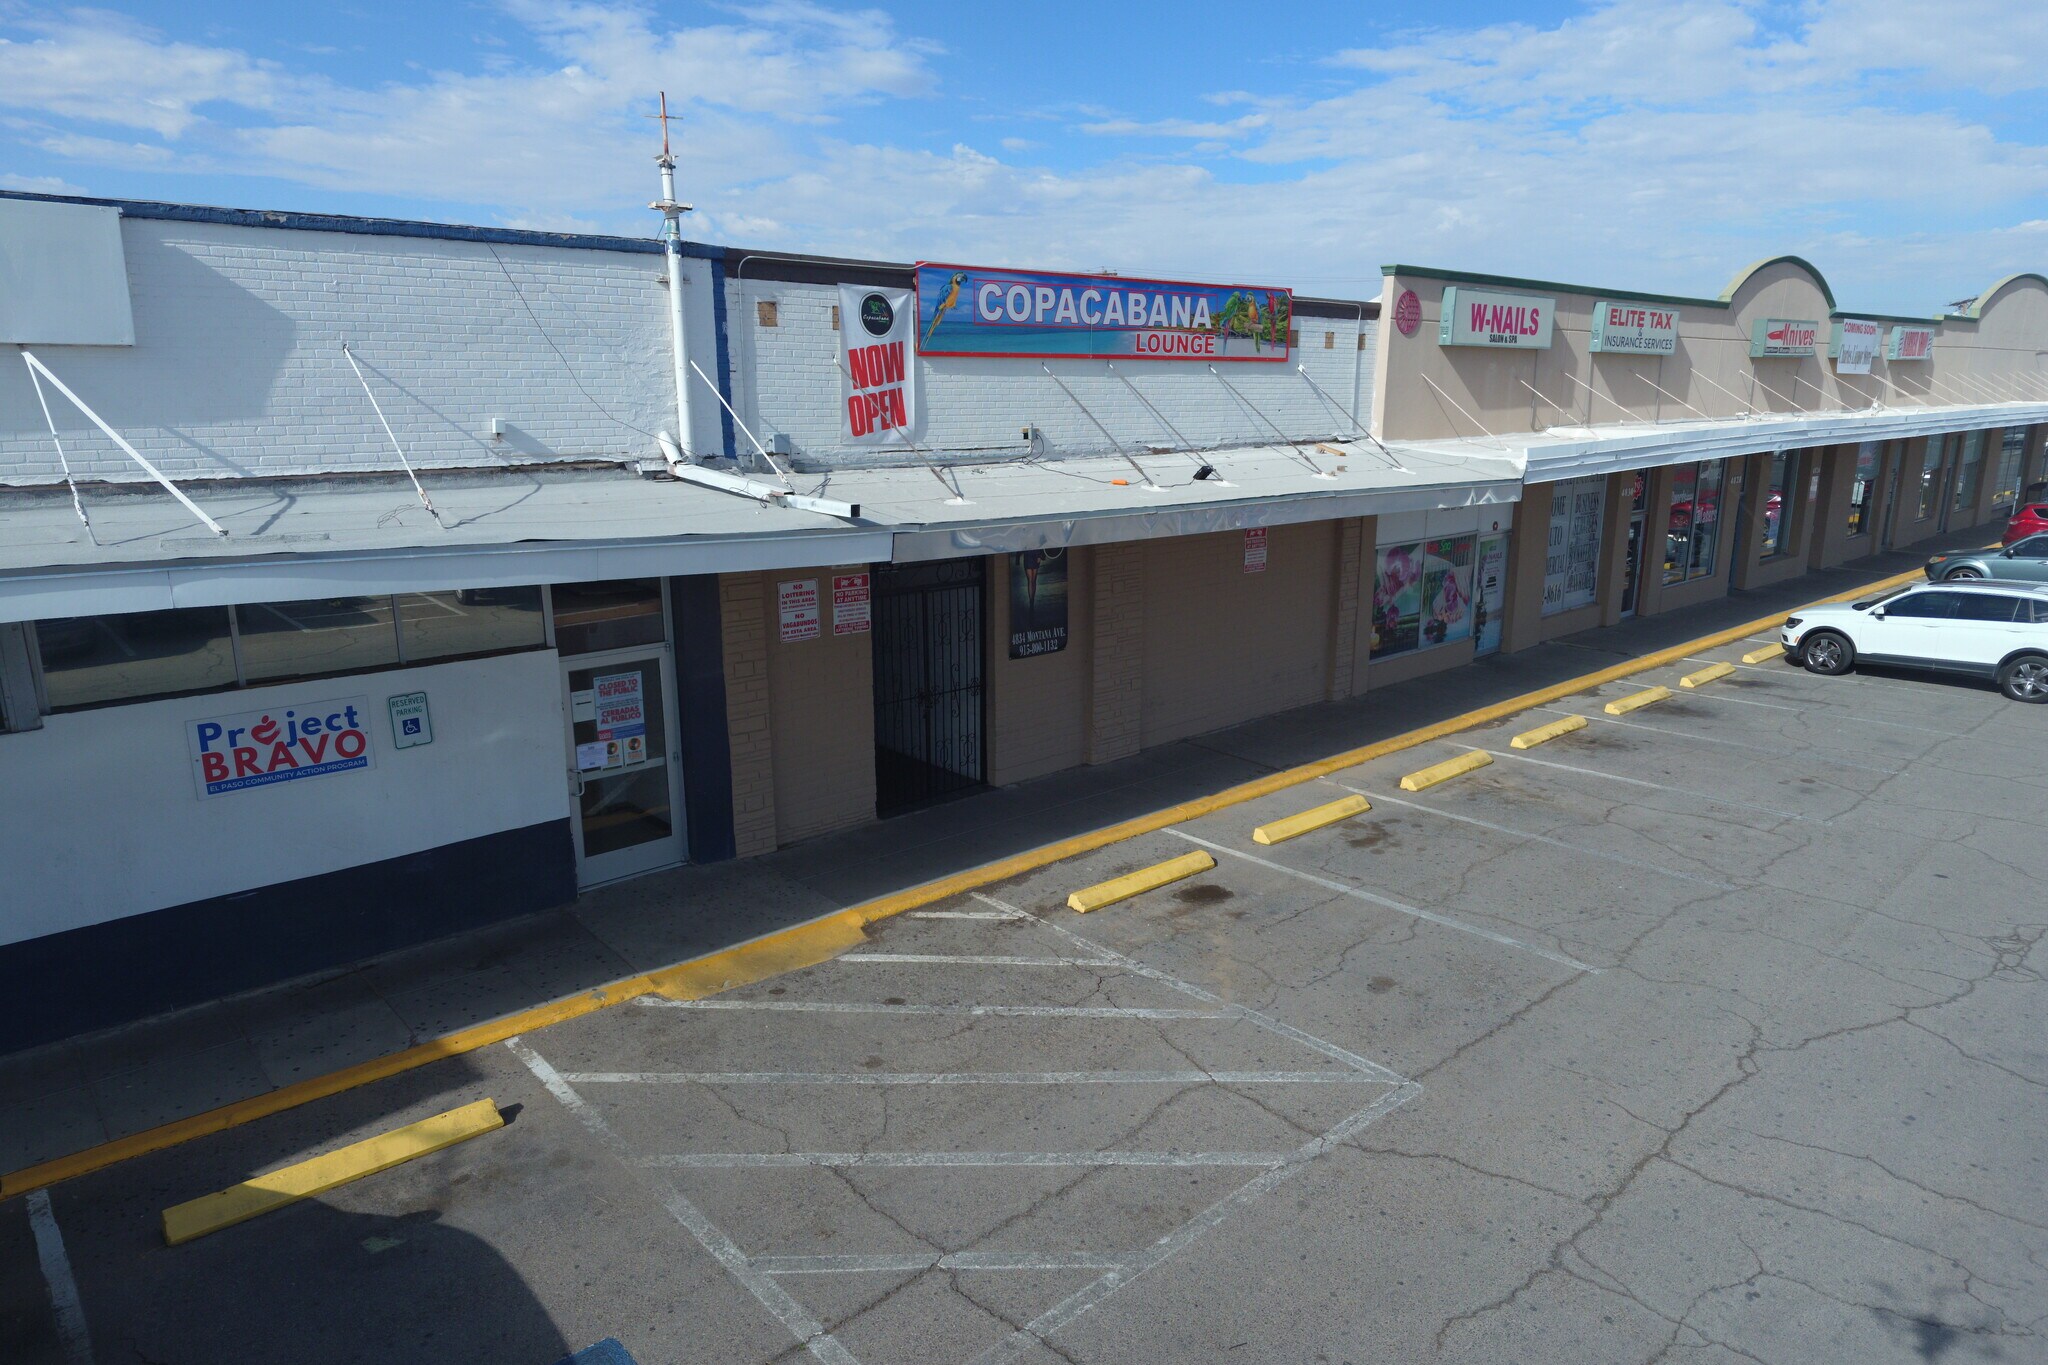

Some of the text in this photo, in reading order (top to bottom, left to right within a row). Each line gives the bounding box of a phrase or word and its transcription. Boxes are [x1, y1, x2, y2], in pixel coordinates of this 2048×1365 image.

[978, 282, 1212, 330] COPACABANA
[1471, 303, 1540, 336] W-NAILS
[1609, 308, 1673, 330] ELITE TAX
[1782, 323, 1815, 346] Knives
[1844, 322, 1877, 335] COMING SOON
[1135, 333, 1216, 354] LOUNGE
[1489, 334, 1504, 343] SALON
[1509, 335, 1518, 344] SPA
[1604, 335, 1673, 350] INSURANCE SERVICES
[848, 341, 905, 390] NOW
[847, 387, 907, 437] OPEN
[1551, 495, 1567, 517] OME
[1549, 526, 1563, 547] UTO
[781, 590, 816, 599] LOITERING
[844, 594, 868, 603] ANYTIME
[845, 589, 868, 597] PARKING
[782, 618, 817, 629] VAGABUNDOS
[1027, 630, 1052, 642] MONTANA
[598, 678, 638, 690] CLOSED TO
[599, 685, 638, 698] THE PUBLIC
[391, 696, 425, 708] RESERVED
[396, 705, 423, 717] PARKING
[601, 705, 640, 718] CERRADAS
[600, 717, 610, 725] AL
[201, 729, 367, 783] BRAVO
[209, 758, 366, 792] EL PASO COMMUNITY ACTION PROGRAM
